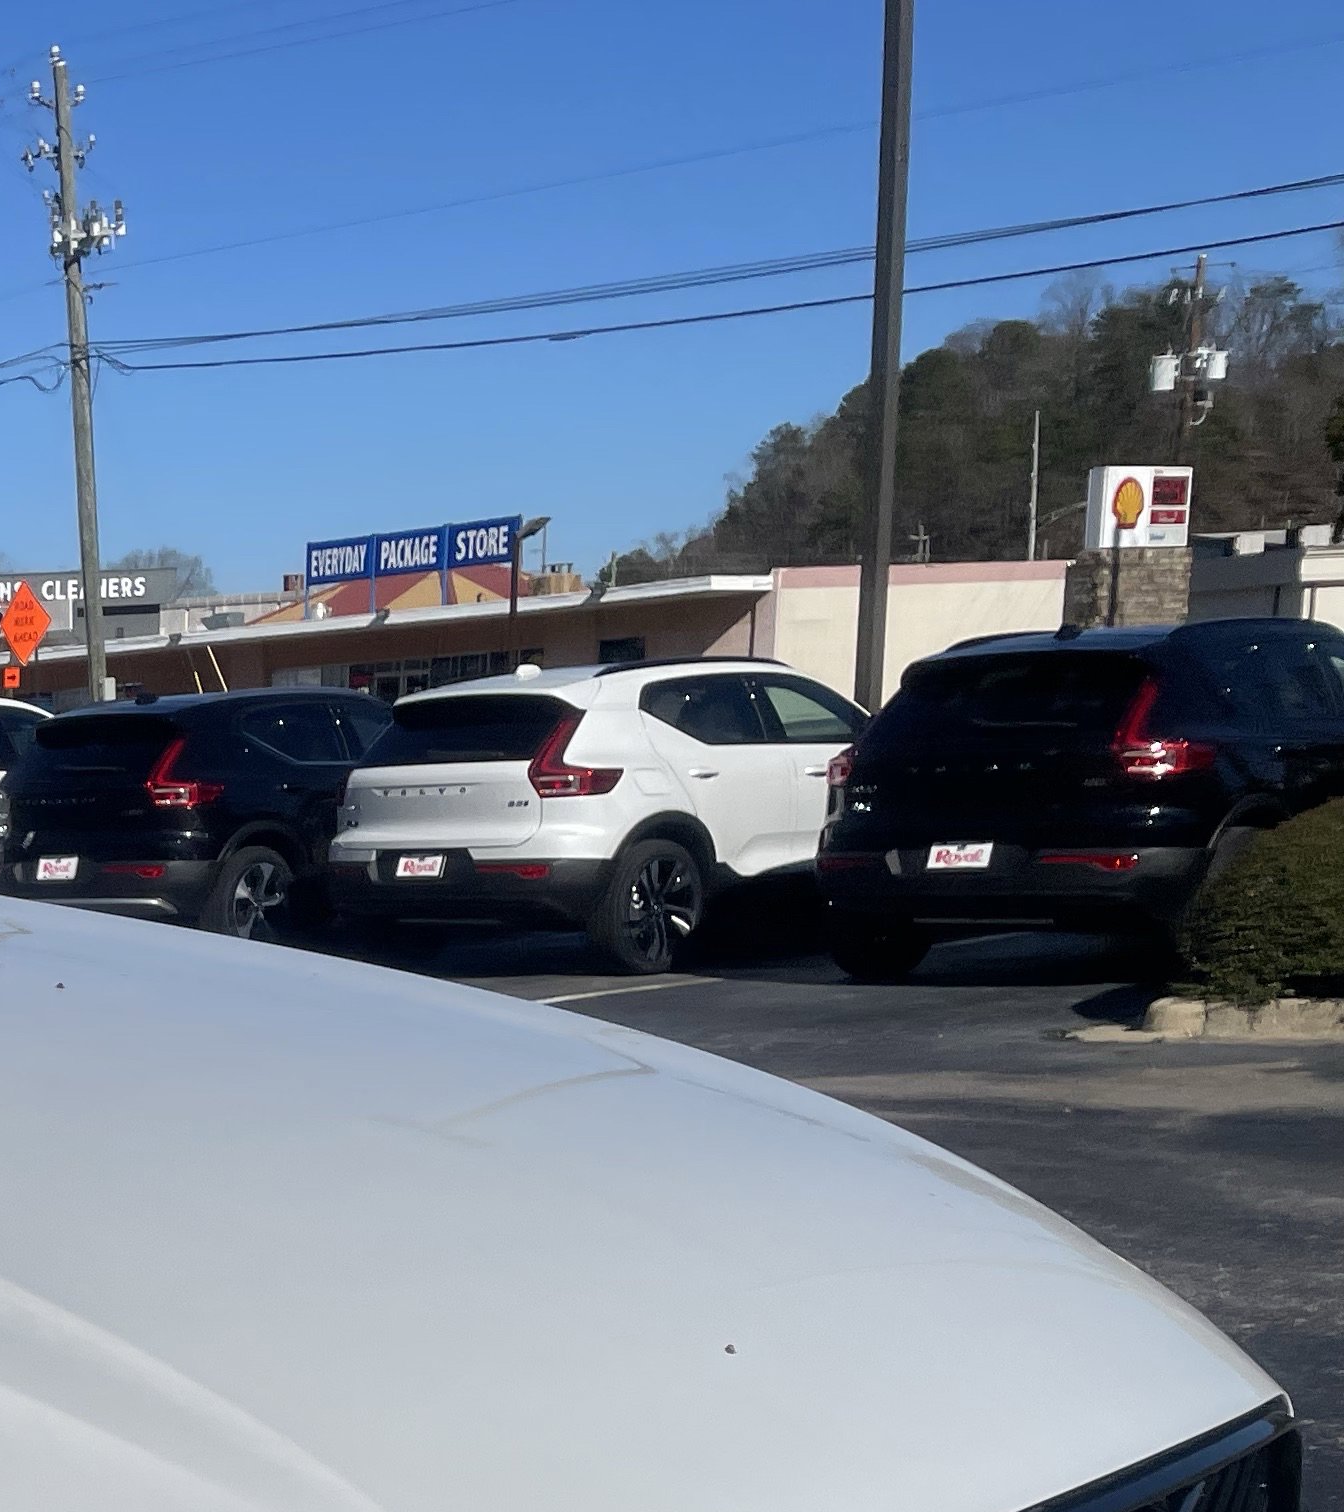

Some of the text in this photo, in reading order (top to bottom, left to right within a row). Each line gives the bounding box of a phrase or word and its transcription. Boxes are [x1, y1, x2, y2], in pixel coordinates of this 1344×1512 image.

[311, 525, 510, 577] EVERYDAY PACKAGE STORE
[934, 849, 985, 866] Royal
